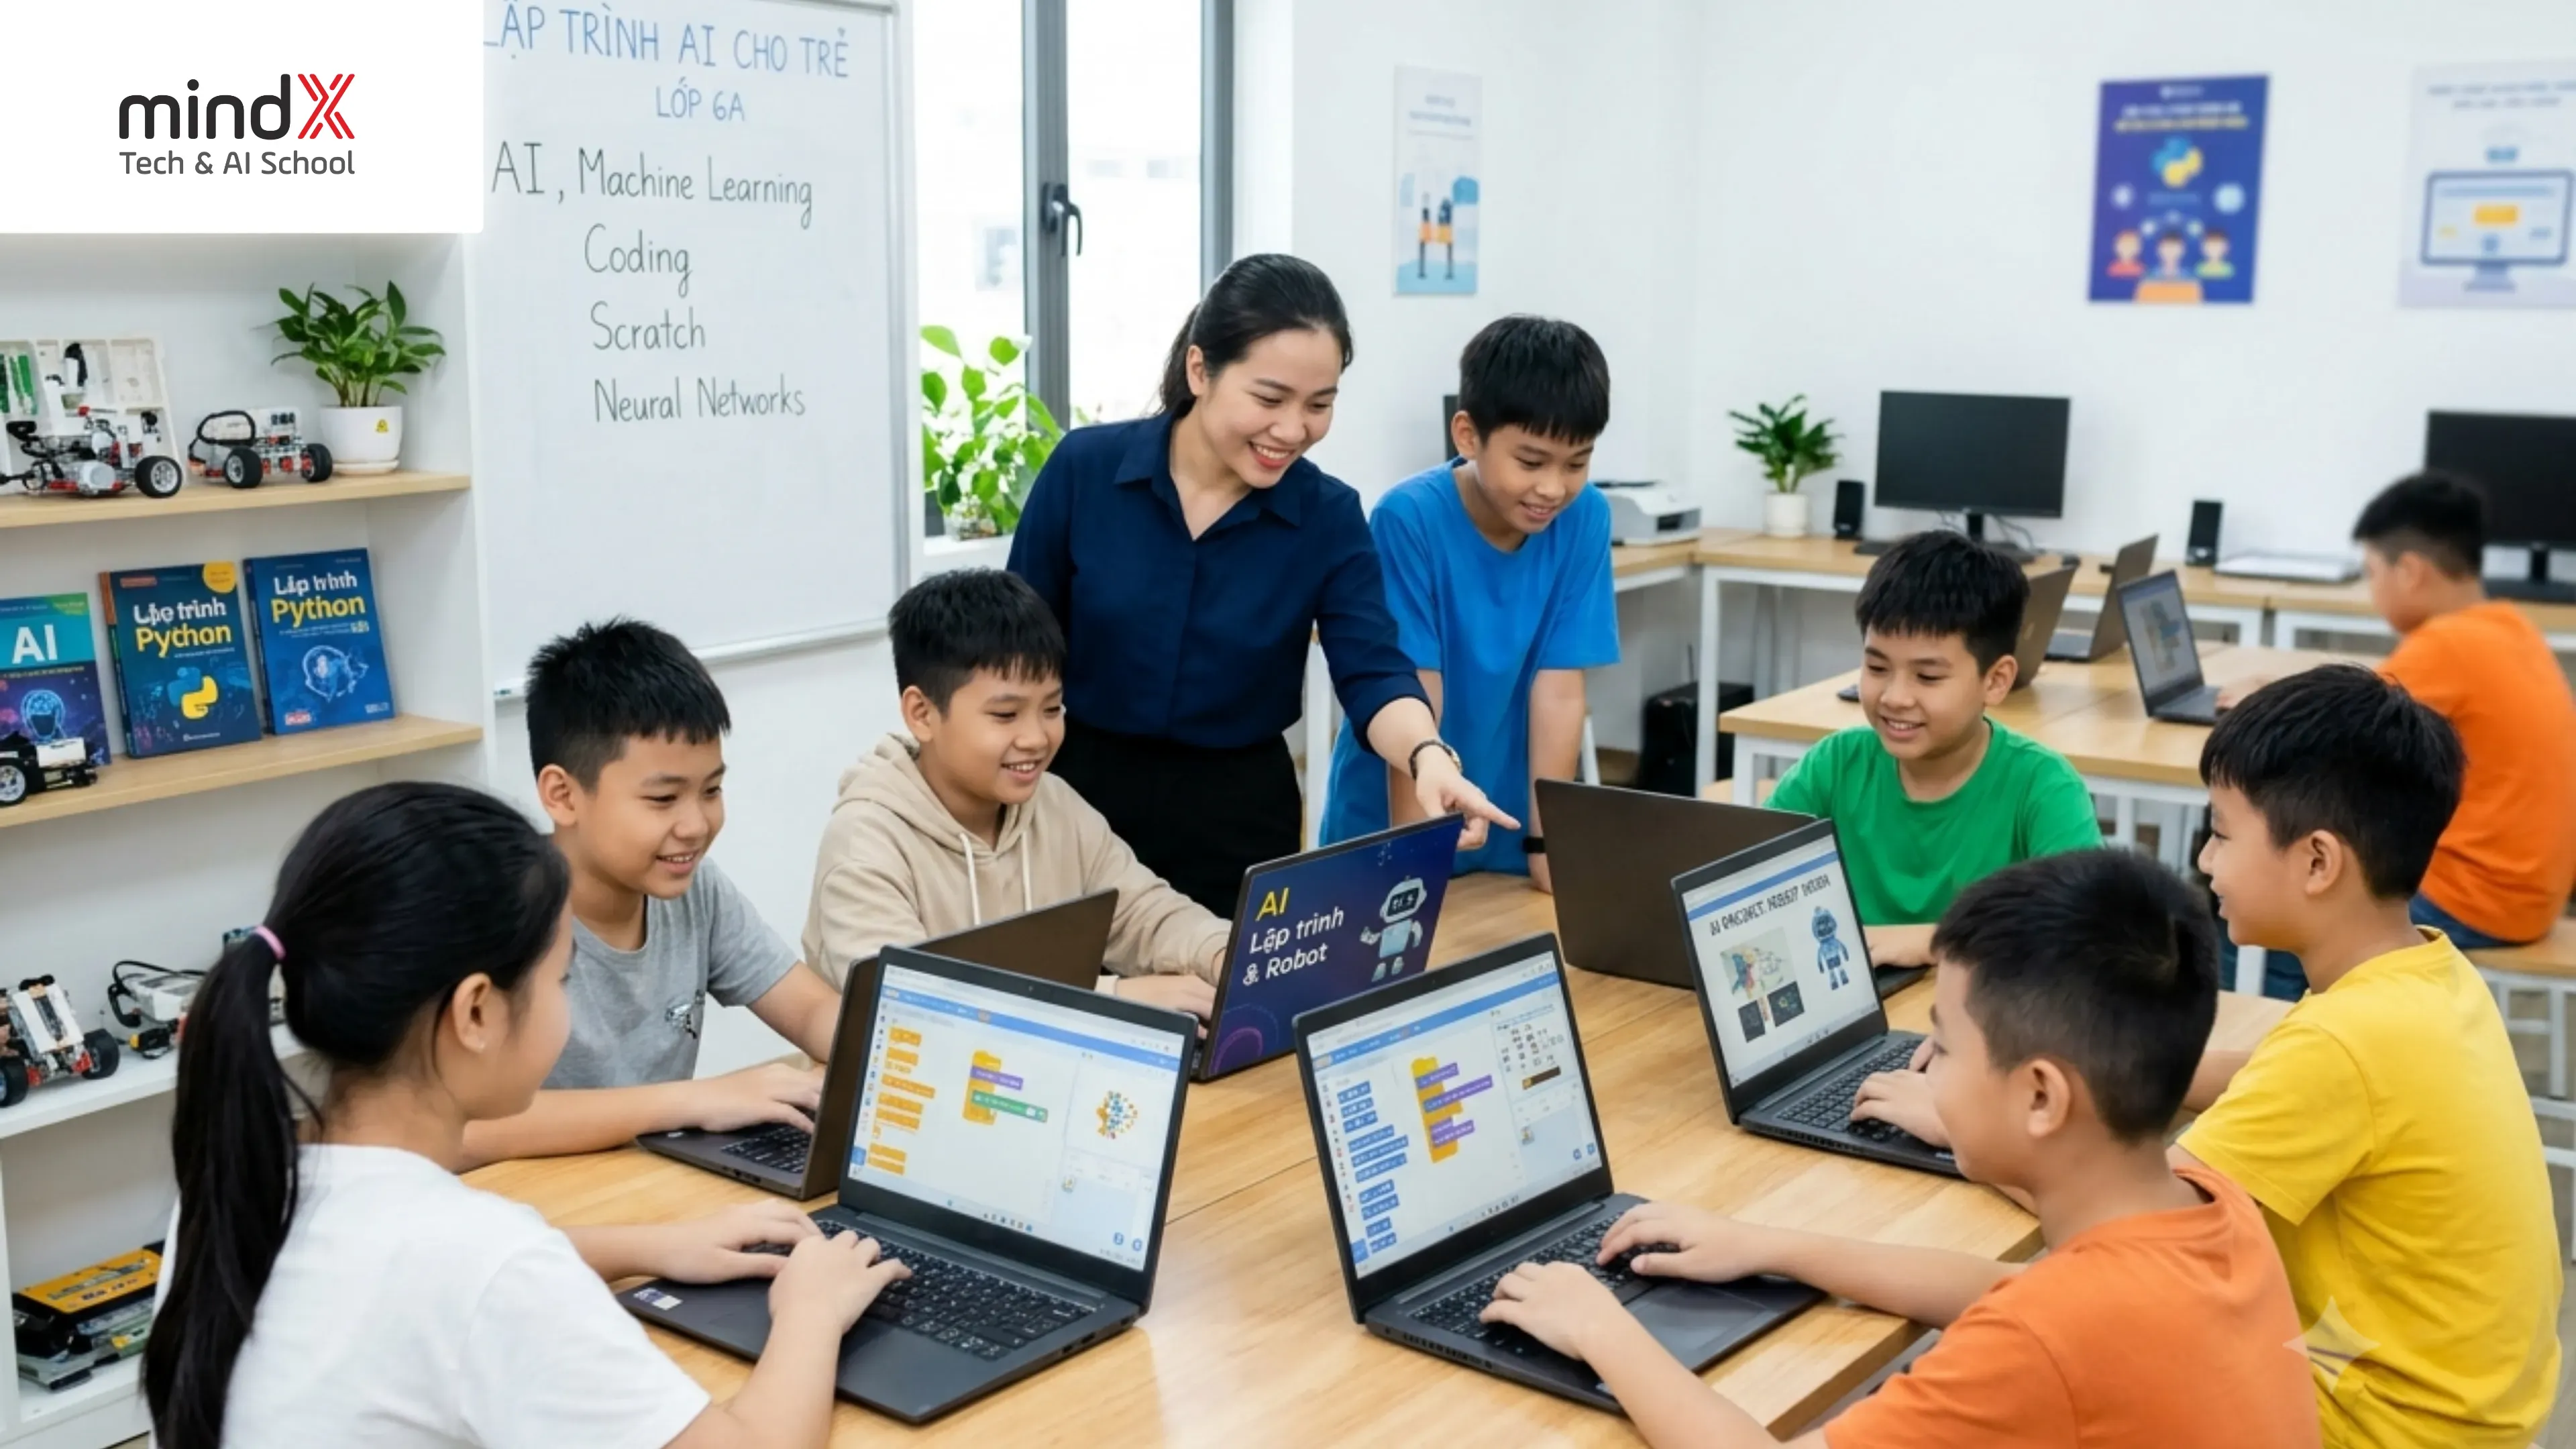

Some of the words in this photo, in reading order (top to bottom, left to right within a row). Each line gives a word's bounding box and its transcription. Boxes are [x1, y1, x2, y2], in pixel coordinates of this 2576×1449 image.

[559, 3, 659, 61] TRÌNH
[678, 23, 716, 67] AI
[734, 30, 788, 72] CHO
[712, 91, 745, 121] 6A
[578, 147, 694, 200] Machine
[708, 156, 812, 229] Learning
[584, 223, 692, 298] Coding
[590, 301, 706, 351] Scratch
[594, 376, 682, 423] Neural
[697, 373, 806, 417] Networks
[270, 595, 366, 628] Python
[11, 624, 58, 665] AI
[1255, 887, 1289, 922] AI
[1242, 962, 1260, 986] &
[1265, 943, 1328, 979] Robot
